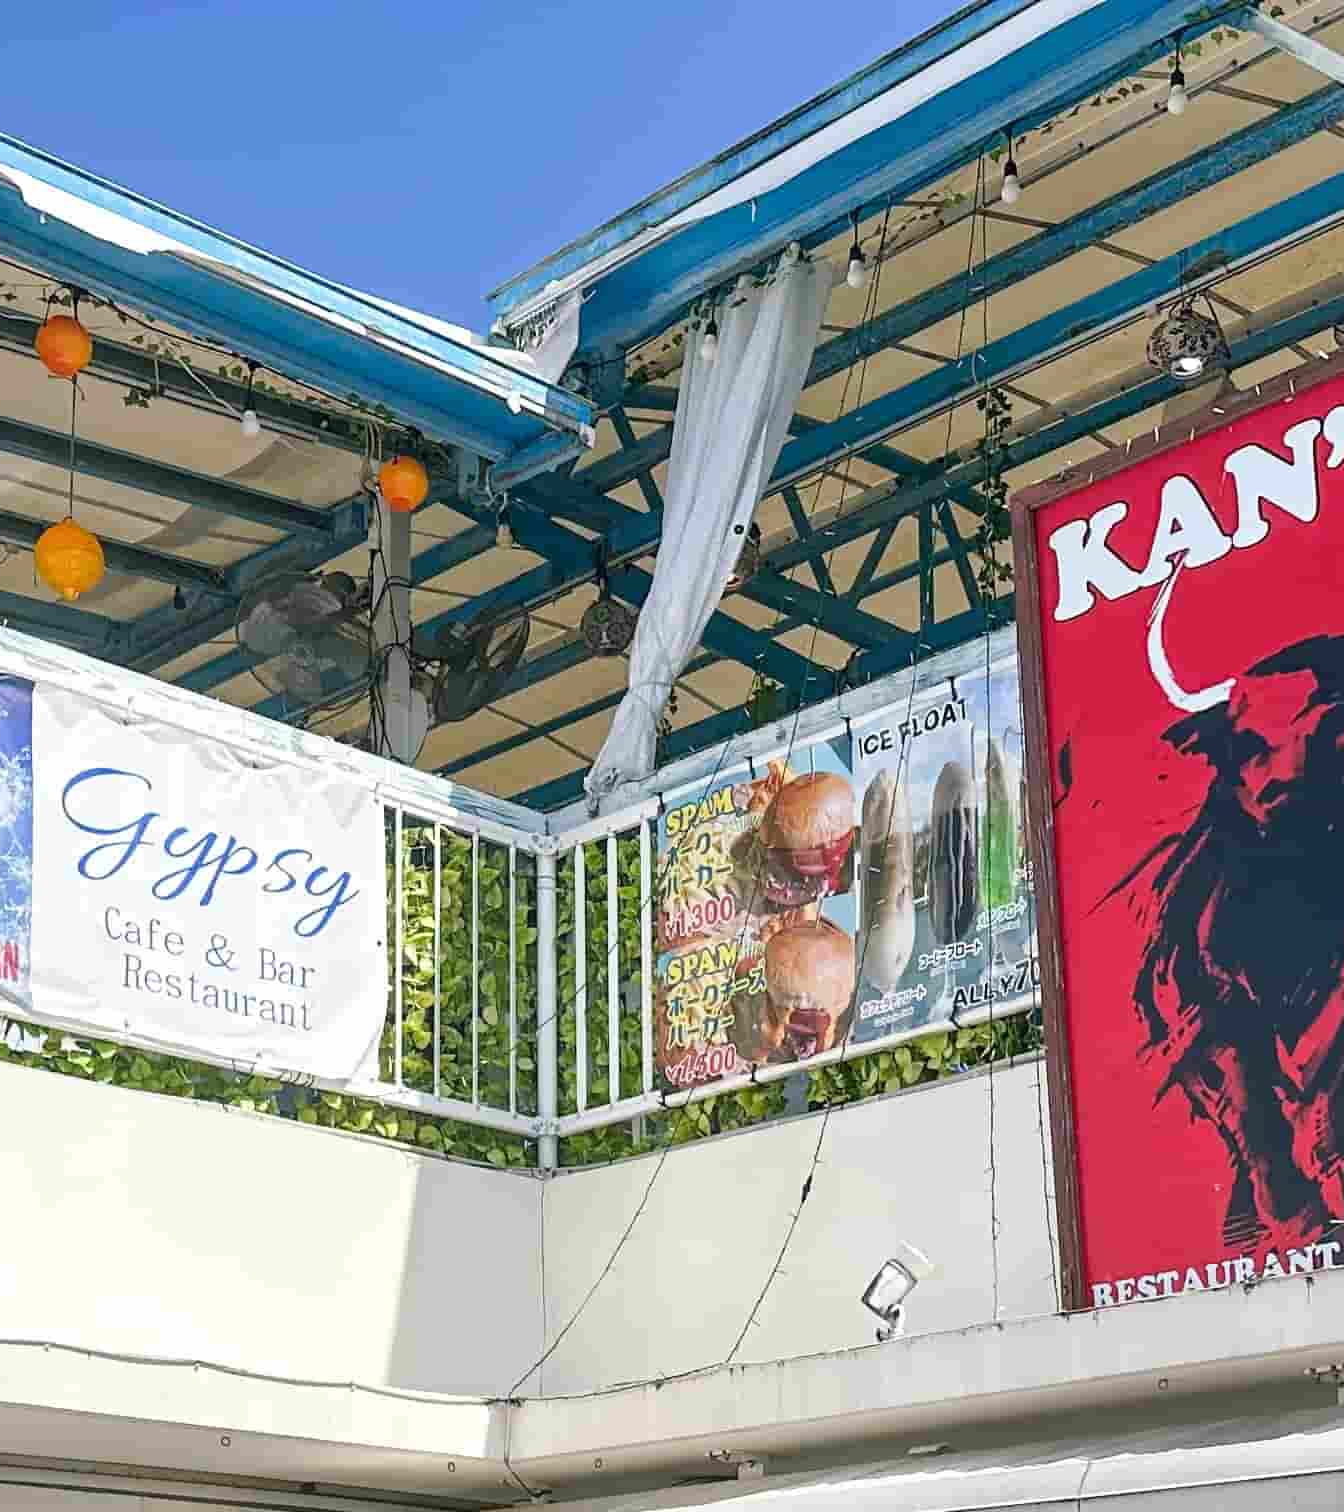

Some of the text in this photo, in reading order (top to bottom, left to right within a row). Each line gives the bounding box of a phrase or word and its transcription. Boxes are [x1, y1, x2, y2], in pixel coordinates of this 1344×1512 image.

[858, 701, 969, 760] ICE FLOAT
[665, 784, 737, 837] SPAM
[61, 766, 360, 937] Gypsy
[104, 907, 319, 990] Cafe & Bar
[666, 943, 738, 985] SPAM
[122, 954, 314, 1032] Restaurant
[954, 981, 995, 1009] ALL
[1092, 1241, 1341, 1308] RESTAURANT
